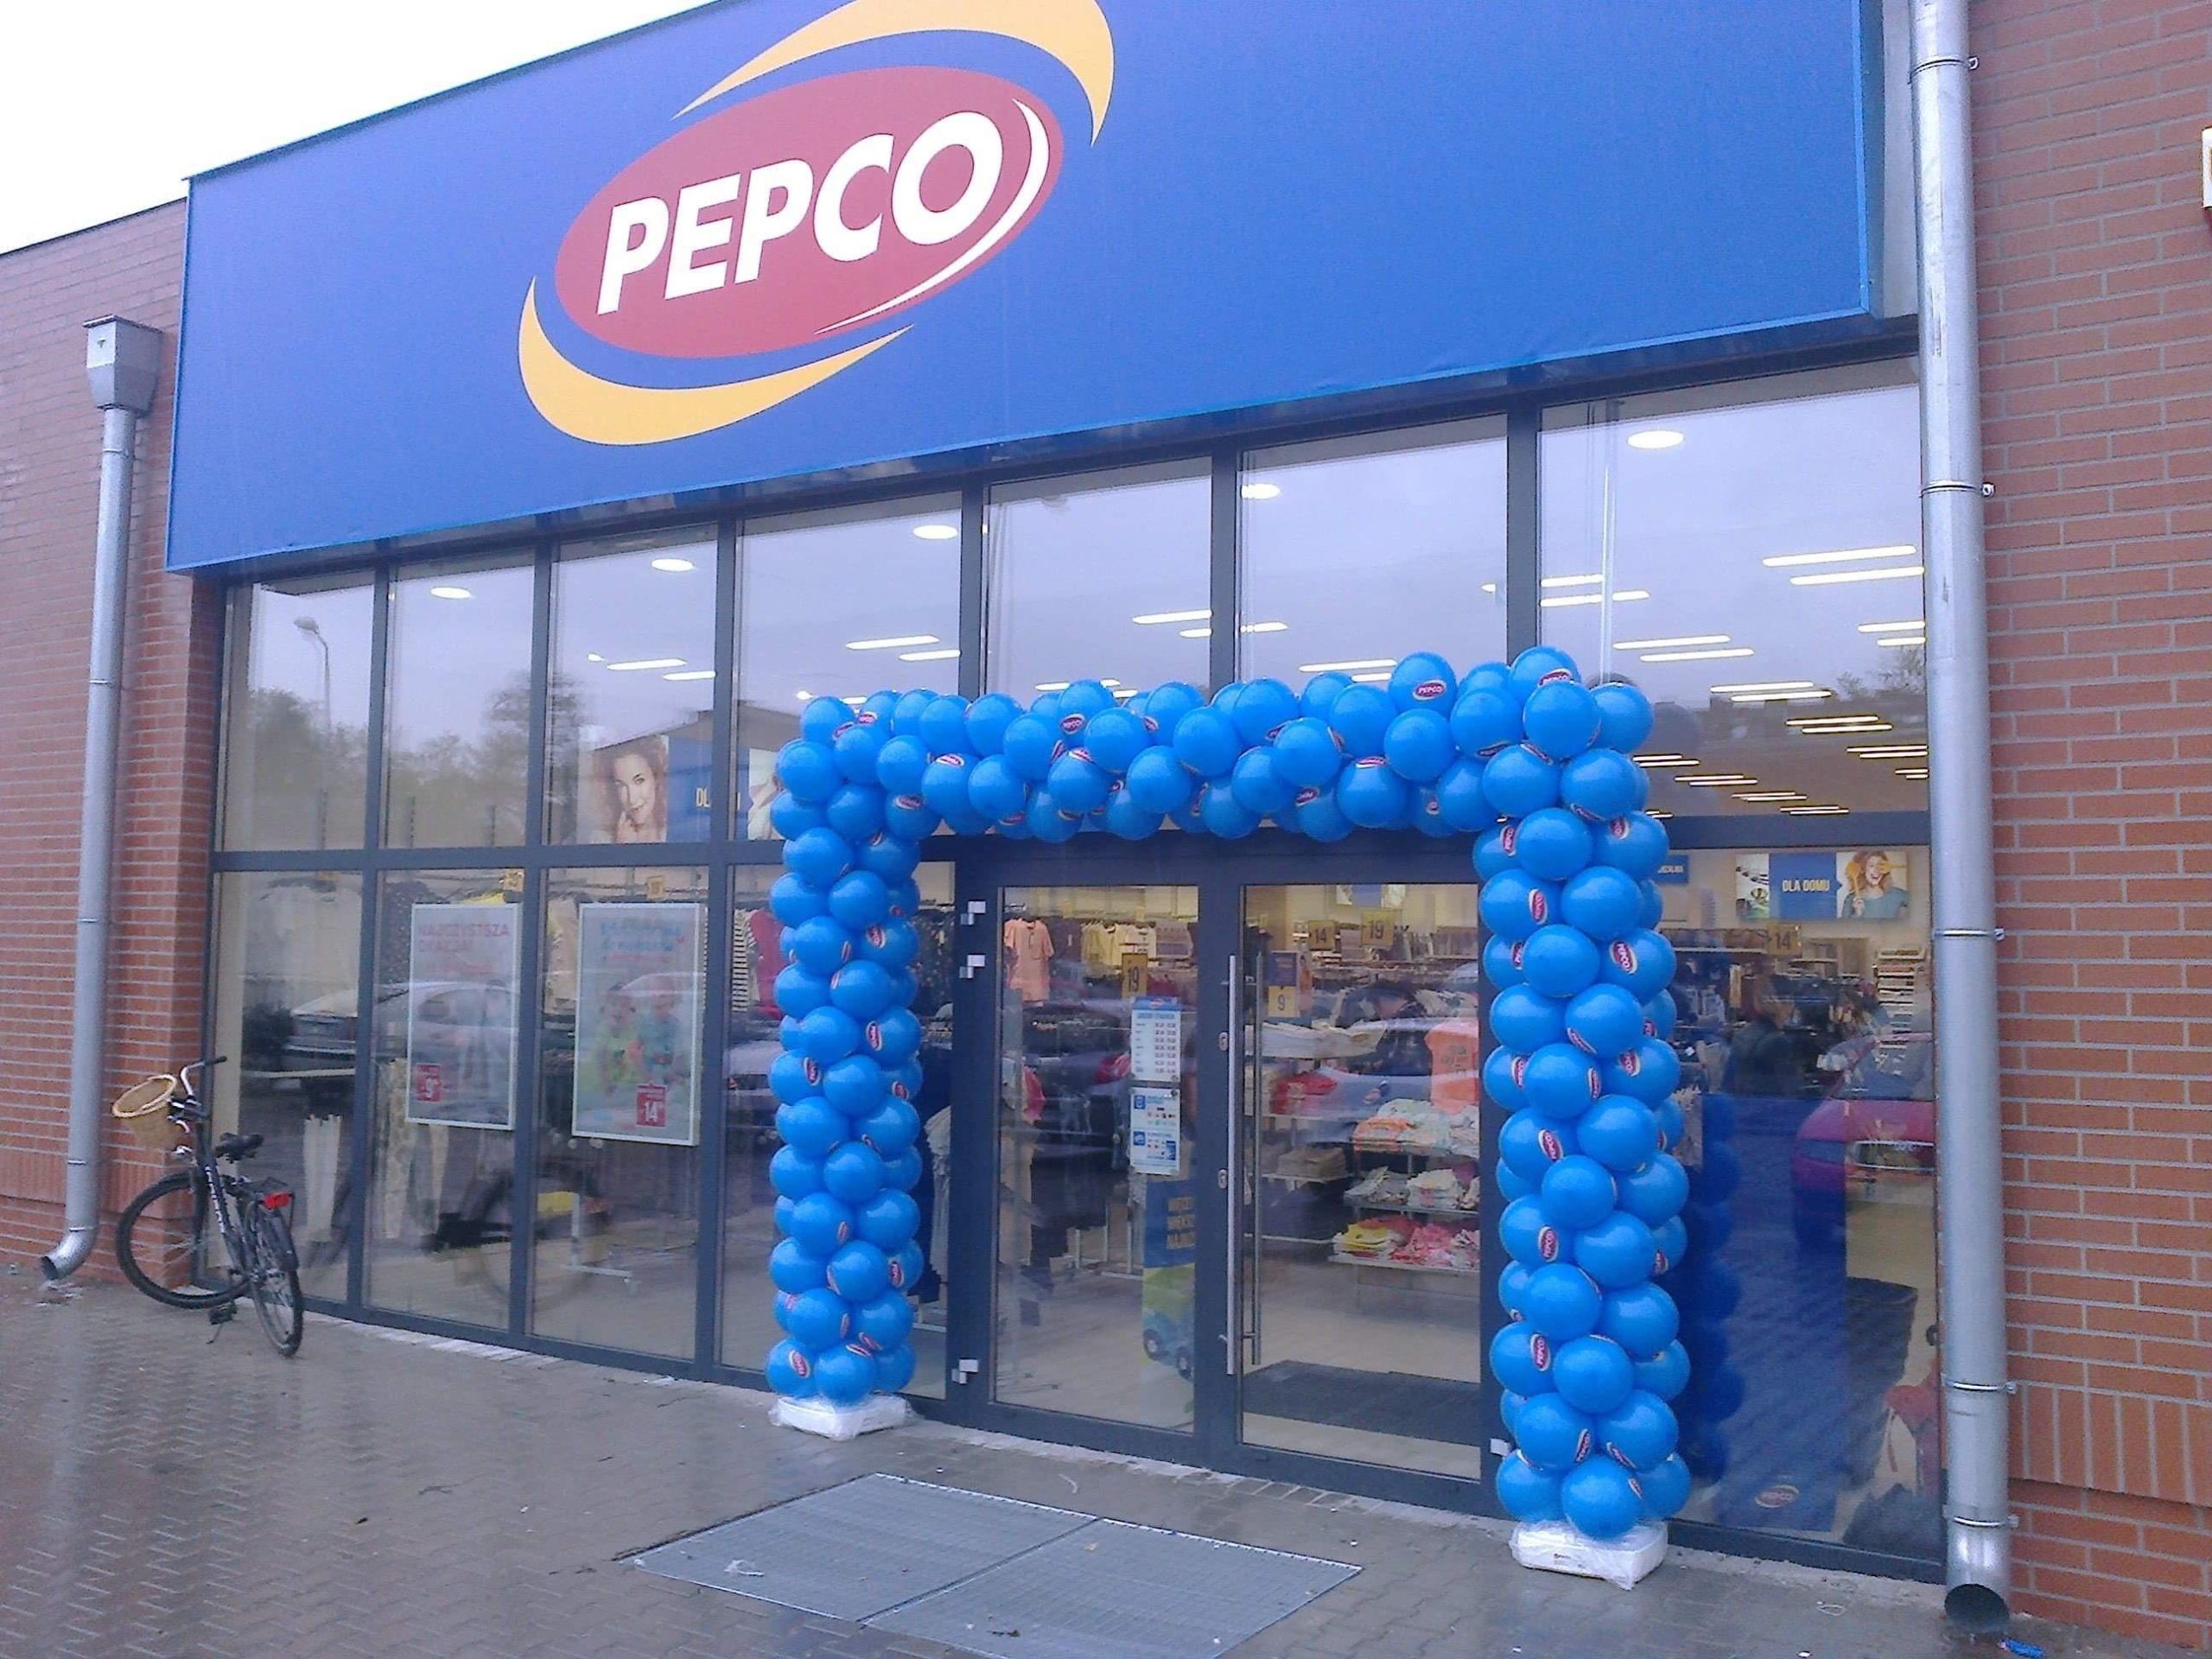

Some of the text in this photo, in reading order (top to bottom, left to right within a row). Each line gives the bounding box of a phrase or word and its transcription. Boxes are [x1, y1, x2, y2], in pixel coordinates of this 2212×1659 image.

[596, 111, 1004, 315] PEPCO
[1418, 685, 1443, 694] PEPCO
[1783, 879, 1830, 892] DLA DOMU
[1314, 928, 1326, 943] 14
[1370, 920, 1384, 939] 19
[1776, 931, 1790, 950] 14
[1128, 966, 1140, 993] 19
[1277, 995, 1286, 1011] 9
[644, 1102, 658, 1122] 14
